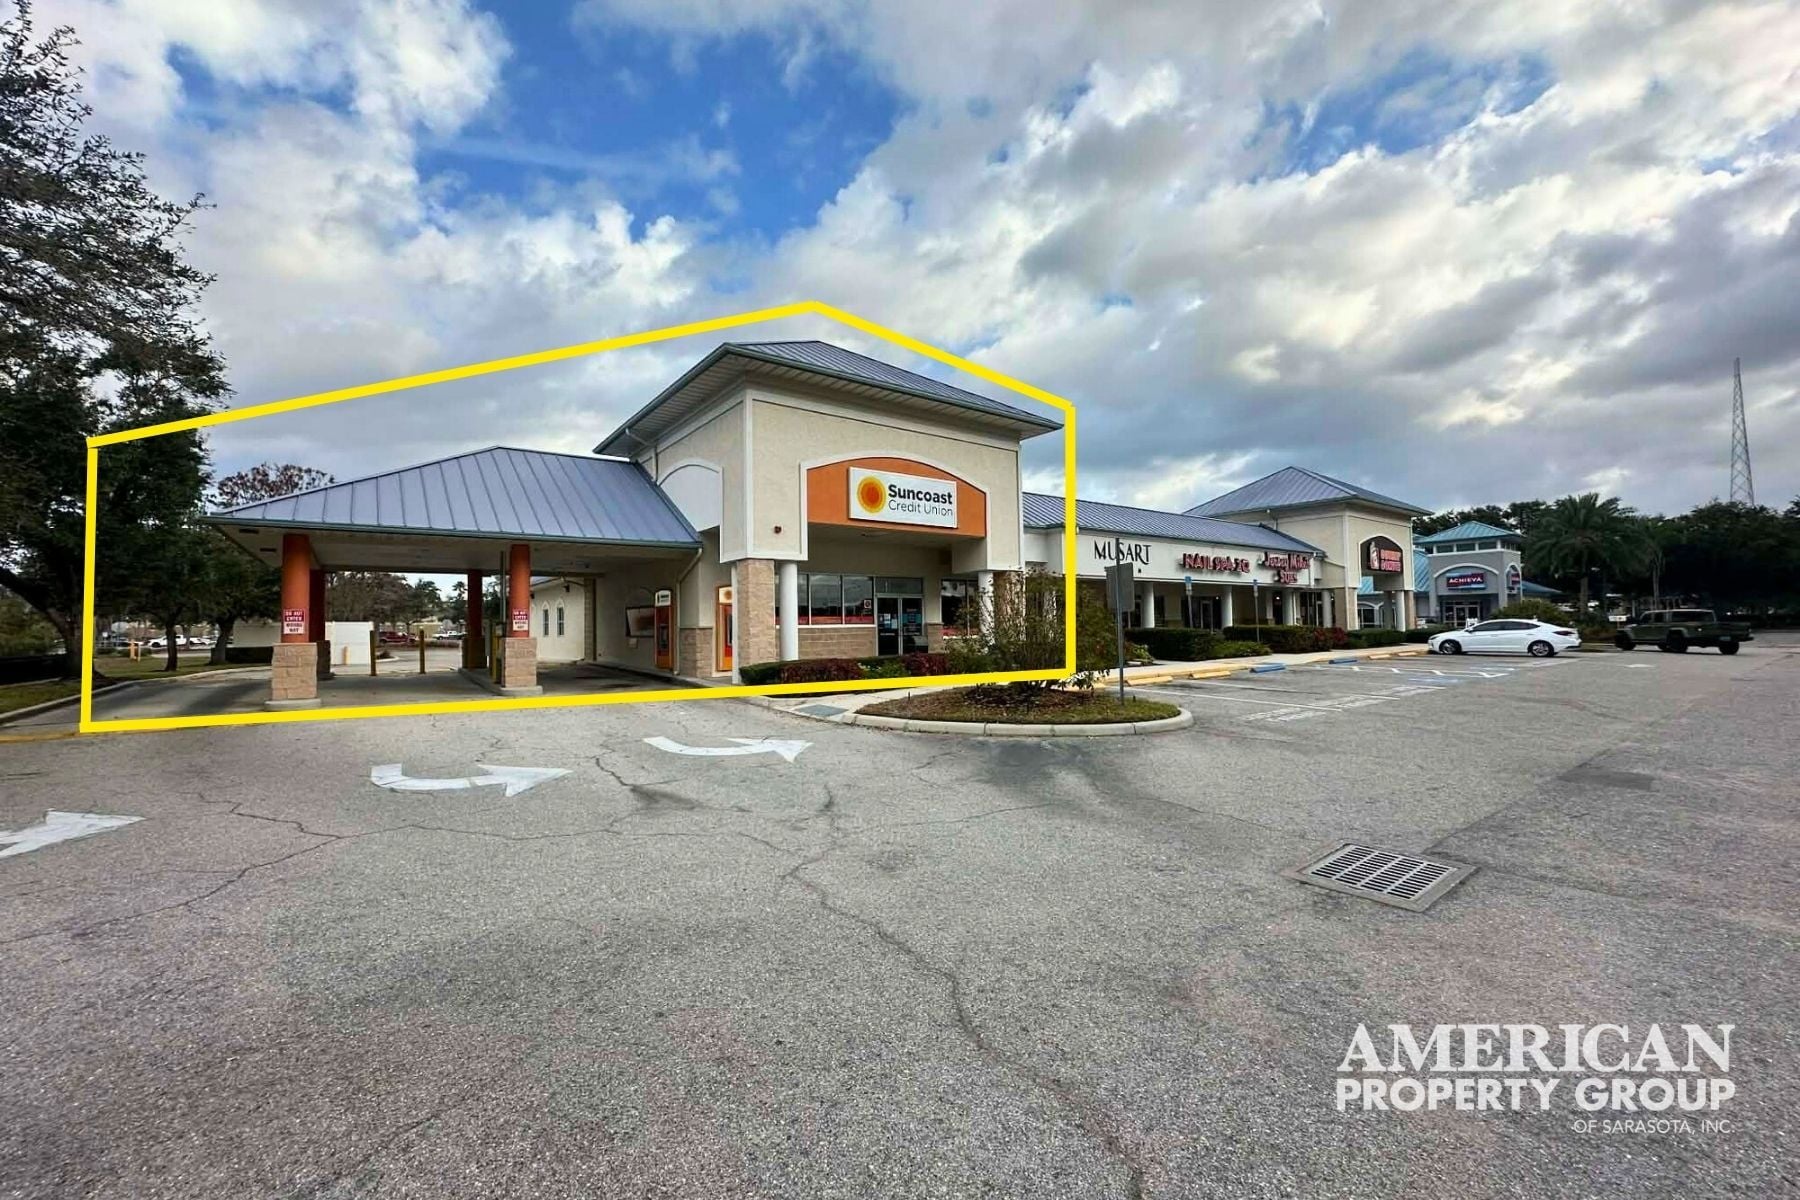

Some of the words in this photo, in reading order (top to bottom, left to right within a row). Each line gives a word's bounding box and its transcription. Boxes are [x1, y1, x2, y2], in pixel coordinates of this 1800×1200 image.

[888, 484, 953, 505] Suncoast
[888, 499, 921, 514] Credit
[923, 503, 953, 516] Union
[1094, 540, 1152, 565] MUSART
[1182, 553, 1213, 570] NAIL
